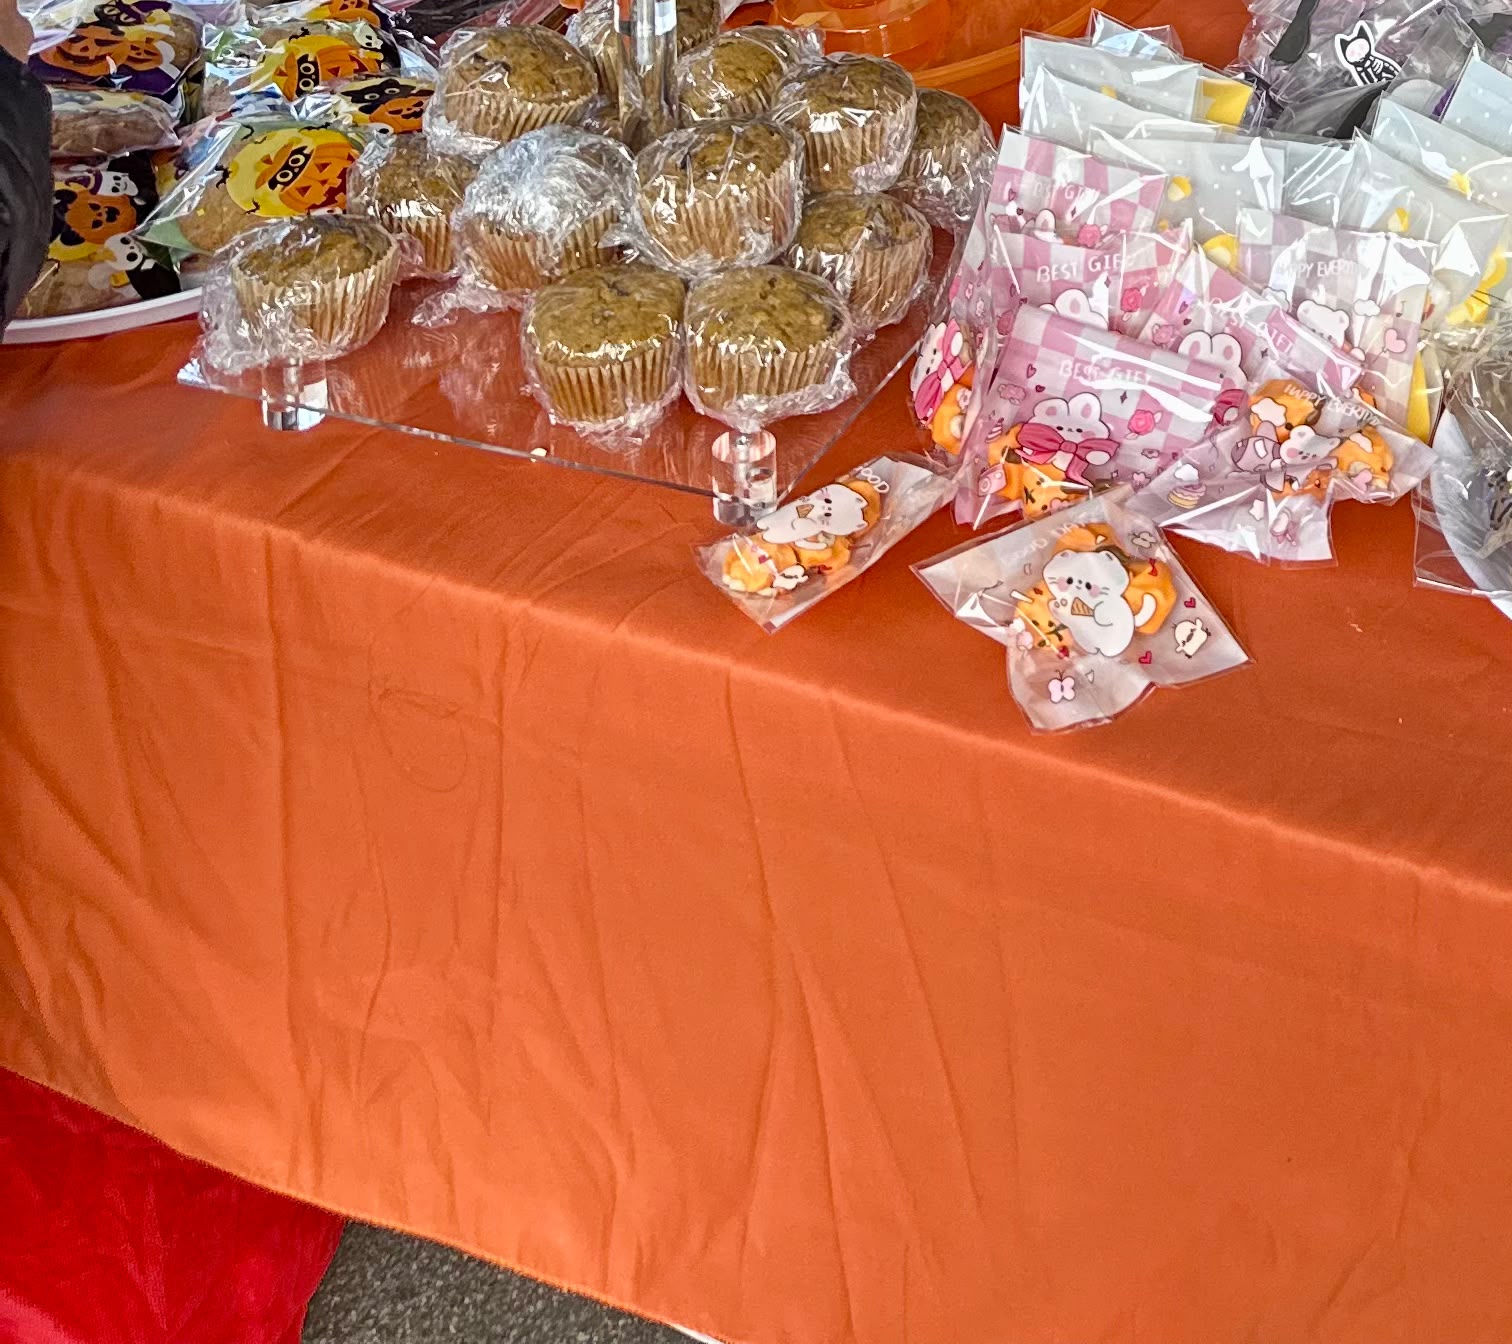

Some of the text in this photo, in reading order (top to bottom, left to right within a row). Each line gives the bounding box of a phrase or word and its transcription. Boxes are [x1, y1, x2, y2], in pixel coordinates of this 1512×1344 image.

[1036, 253, 1123, 283] BEST GIF
[1284, 384, 1326, 407] HAPPY
